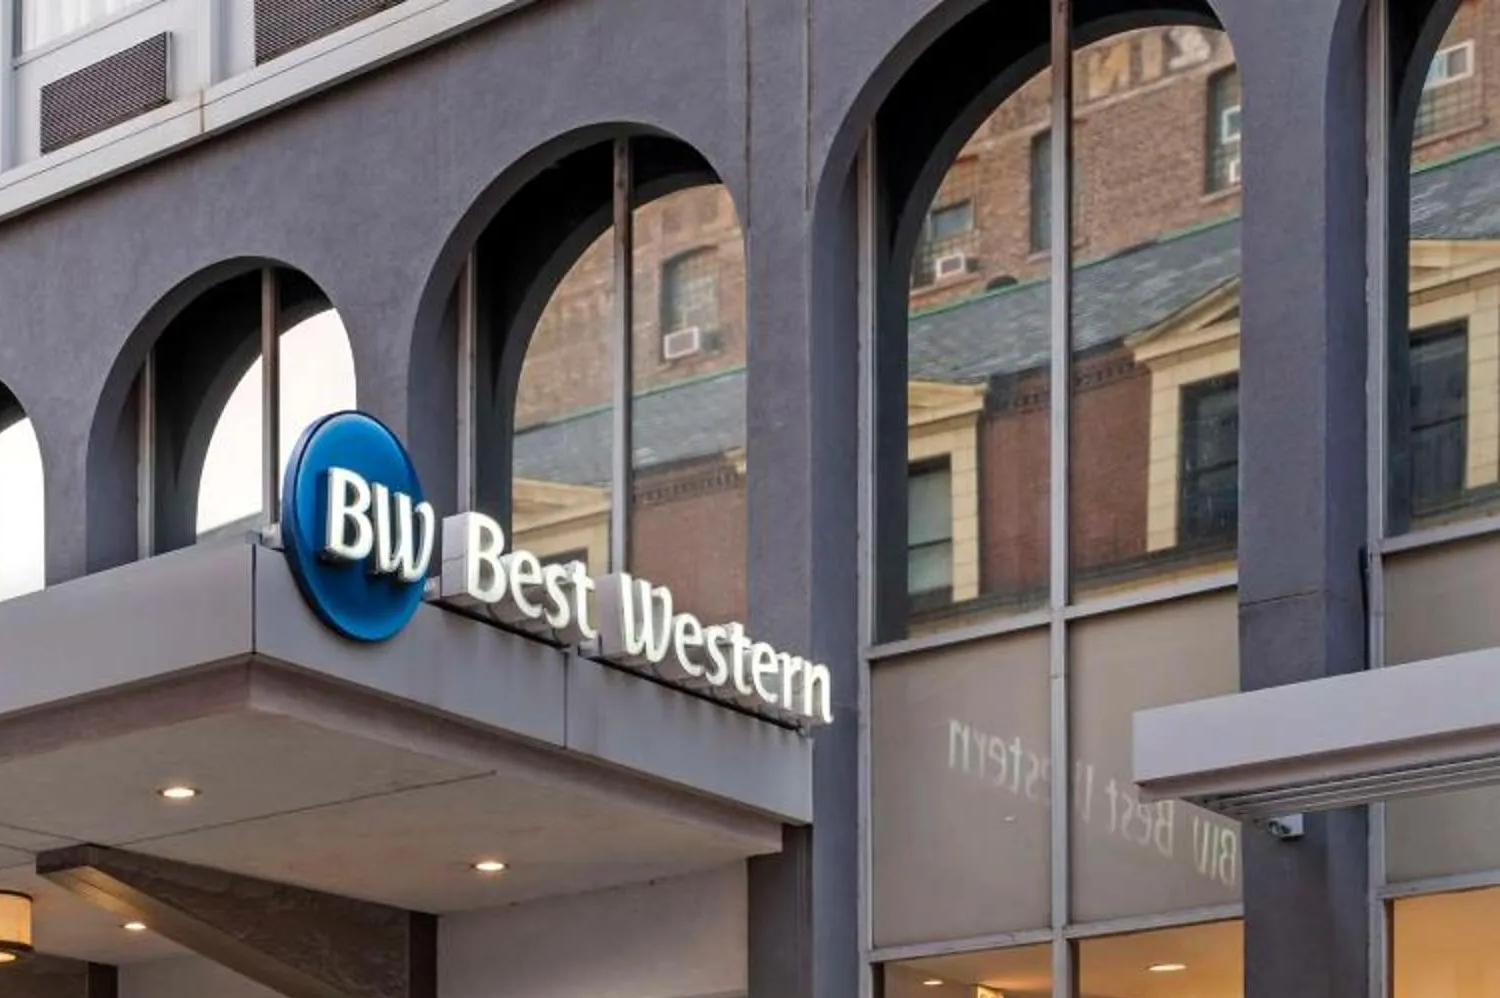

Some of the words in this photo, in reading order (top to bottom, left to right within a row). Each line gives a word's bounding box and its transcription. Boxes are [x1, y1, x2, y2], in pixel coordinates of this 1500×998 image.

[325, 466, 435, 583] BW
[466, 511, 598, 639] Best
[619, 572, 834, 725] Western
